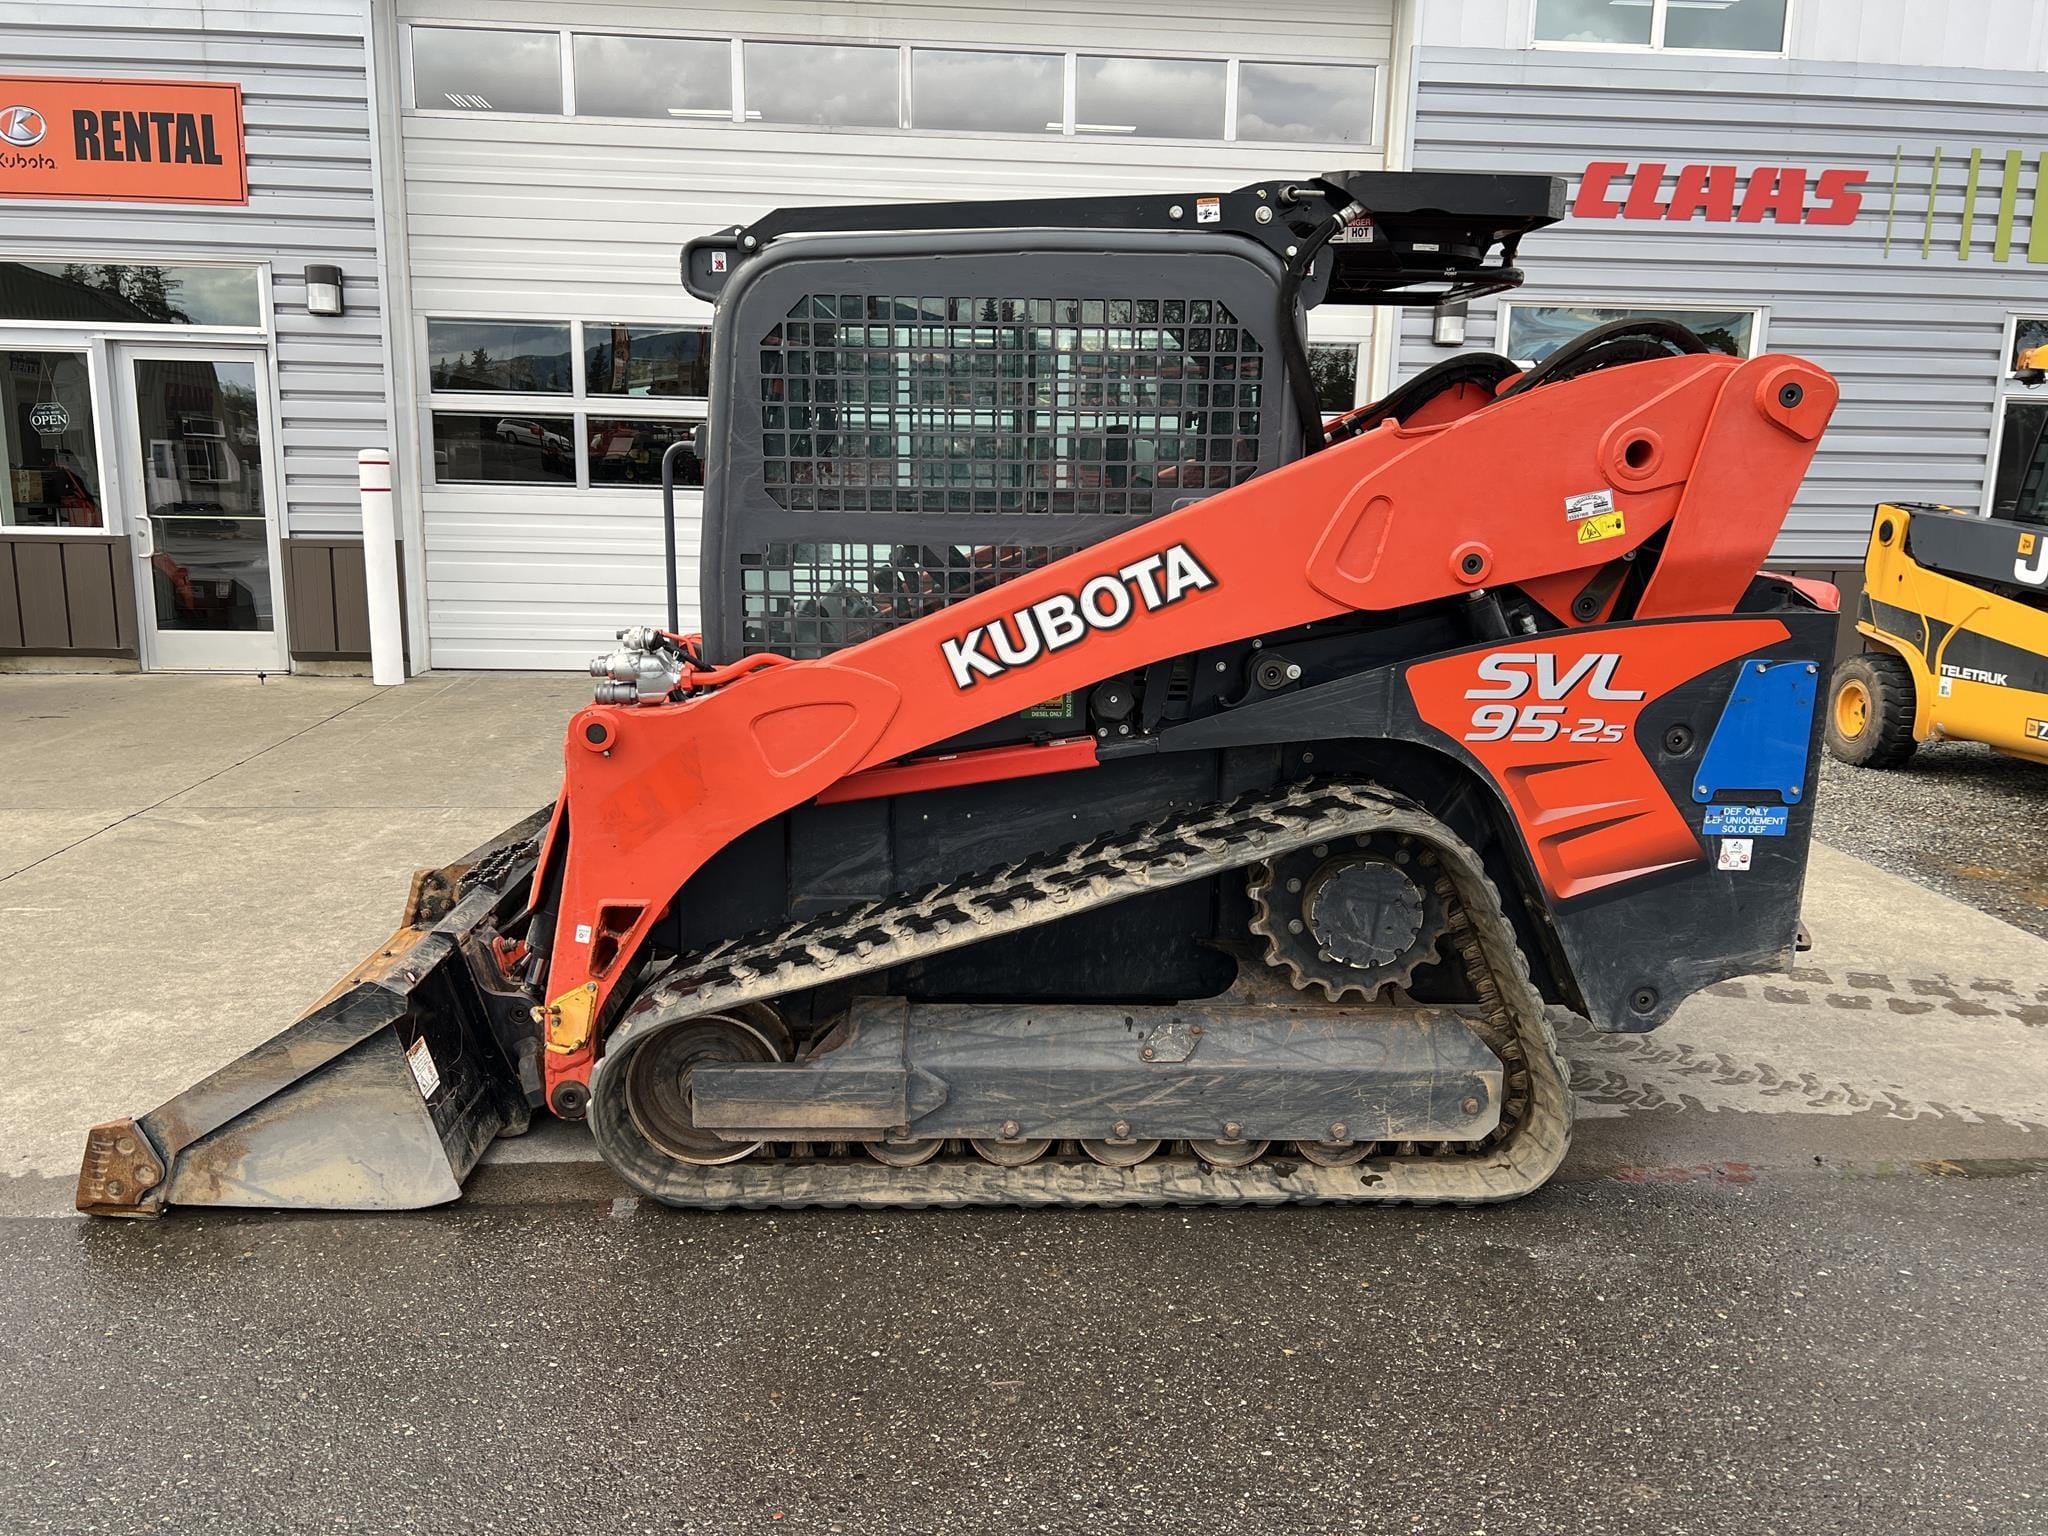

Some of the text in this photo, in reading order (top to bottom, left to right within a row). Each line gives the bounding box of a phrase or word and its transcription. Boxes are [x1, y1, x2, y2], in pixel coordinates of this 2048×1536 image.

[72, 109, 223, 165] RENTAL
[0, 152, 55, 169] Kubota
[1572, 161, 1869, 225] CLAAS
[1347, 218, 1371, 226] NGER
[1351, 227, 1369, 238] HOT
[32, 414, 67, 426] OPEN
[941, 544, 1217, 689] KUBOTA
[1463, 652, 1647, 701] SVL
[1940, 664, 2008, 686] TELETRUK
[1723, 807, 1769, 816] DEF ONLY
[1705, 816, 1785, 825] DEF UNIQUEMENT
[1721, 825, 1767, 834] SOLO DEF
